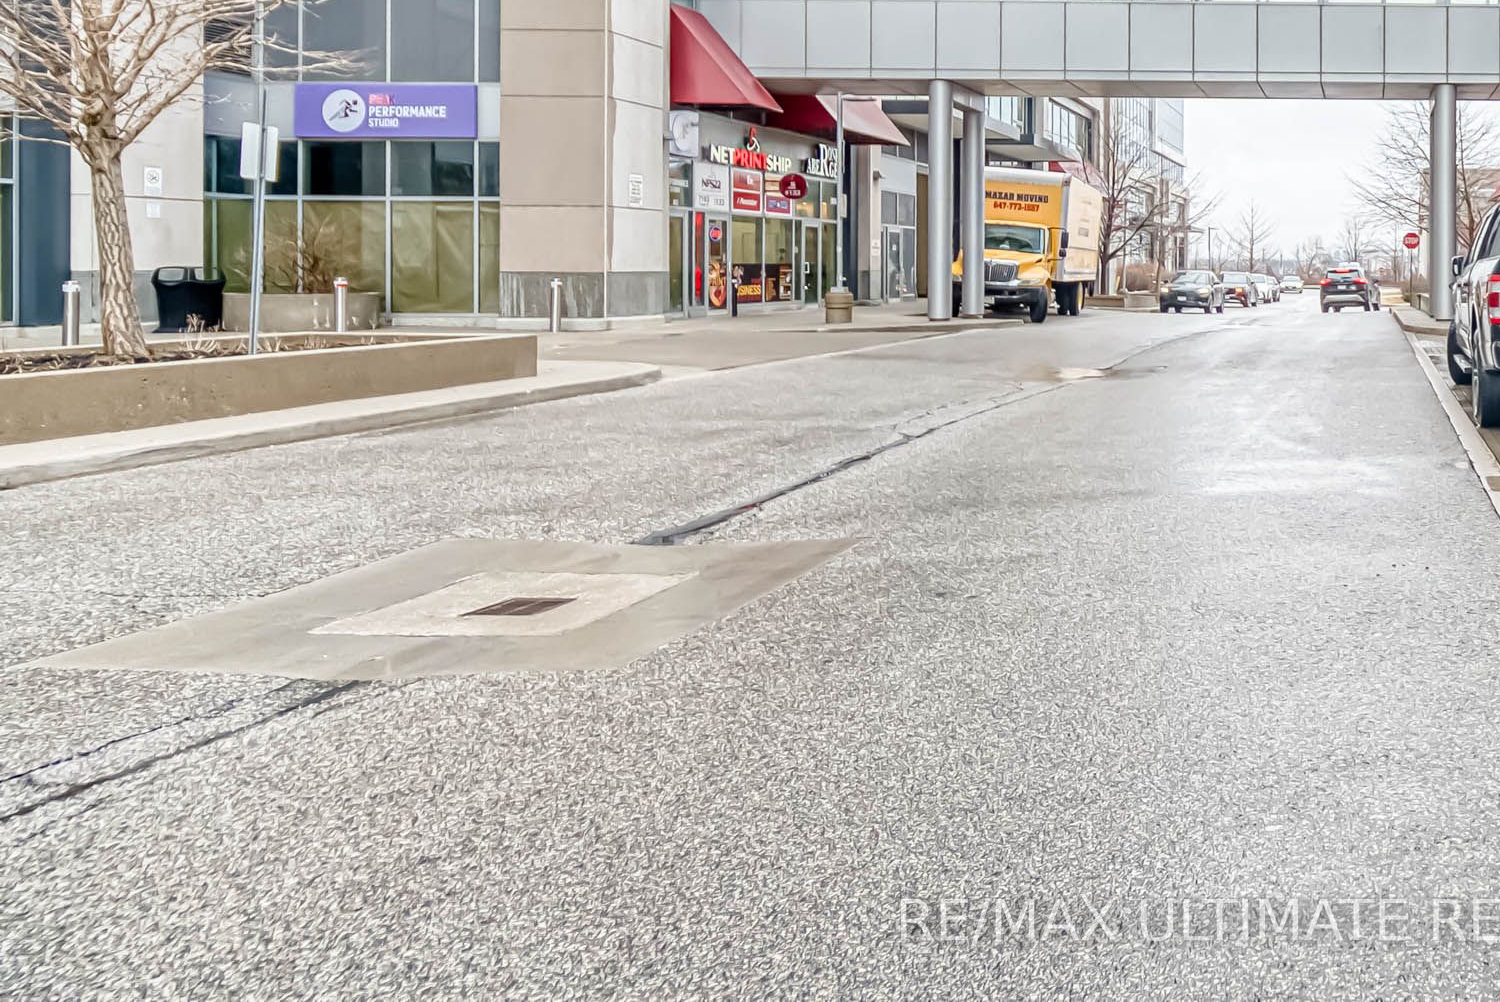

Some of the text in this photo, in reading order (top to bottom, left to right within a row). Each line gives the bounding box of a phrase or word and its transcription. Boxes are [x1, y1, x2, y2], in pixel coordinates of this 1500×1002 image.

[368, 105, 447, 118] PERFORMANCE
[368, 118, 399, 127] STUDIO
[1016, 193, 1048, 204] MOVING
[1404, 236, 1419, 245] STOP
